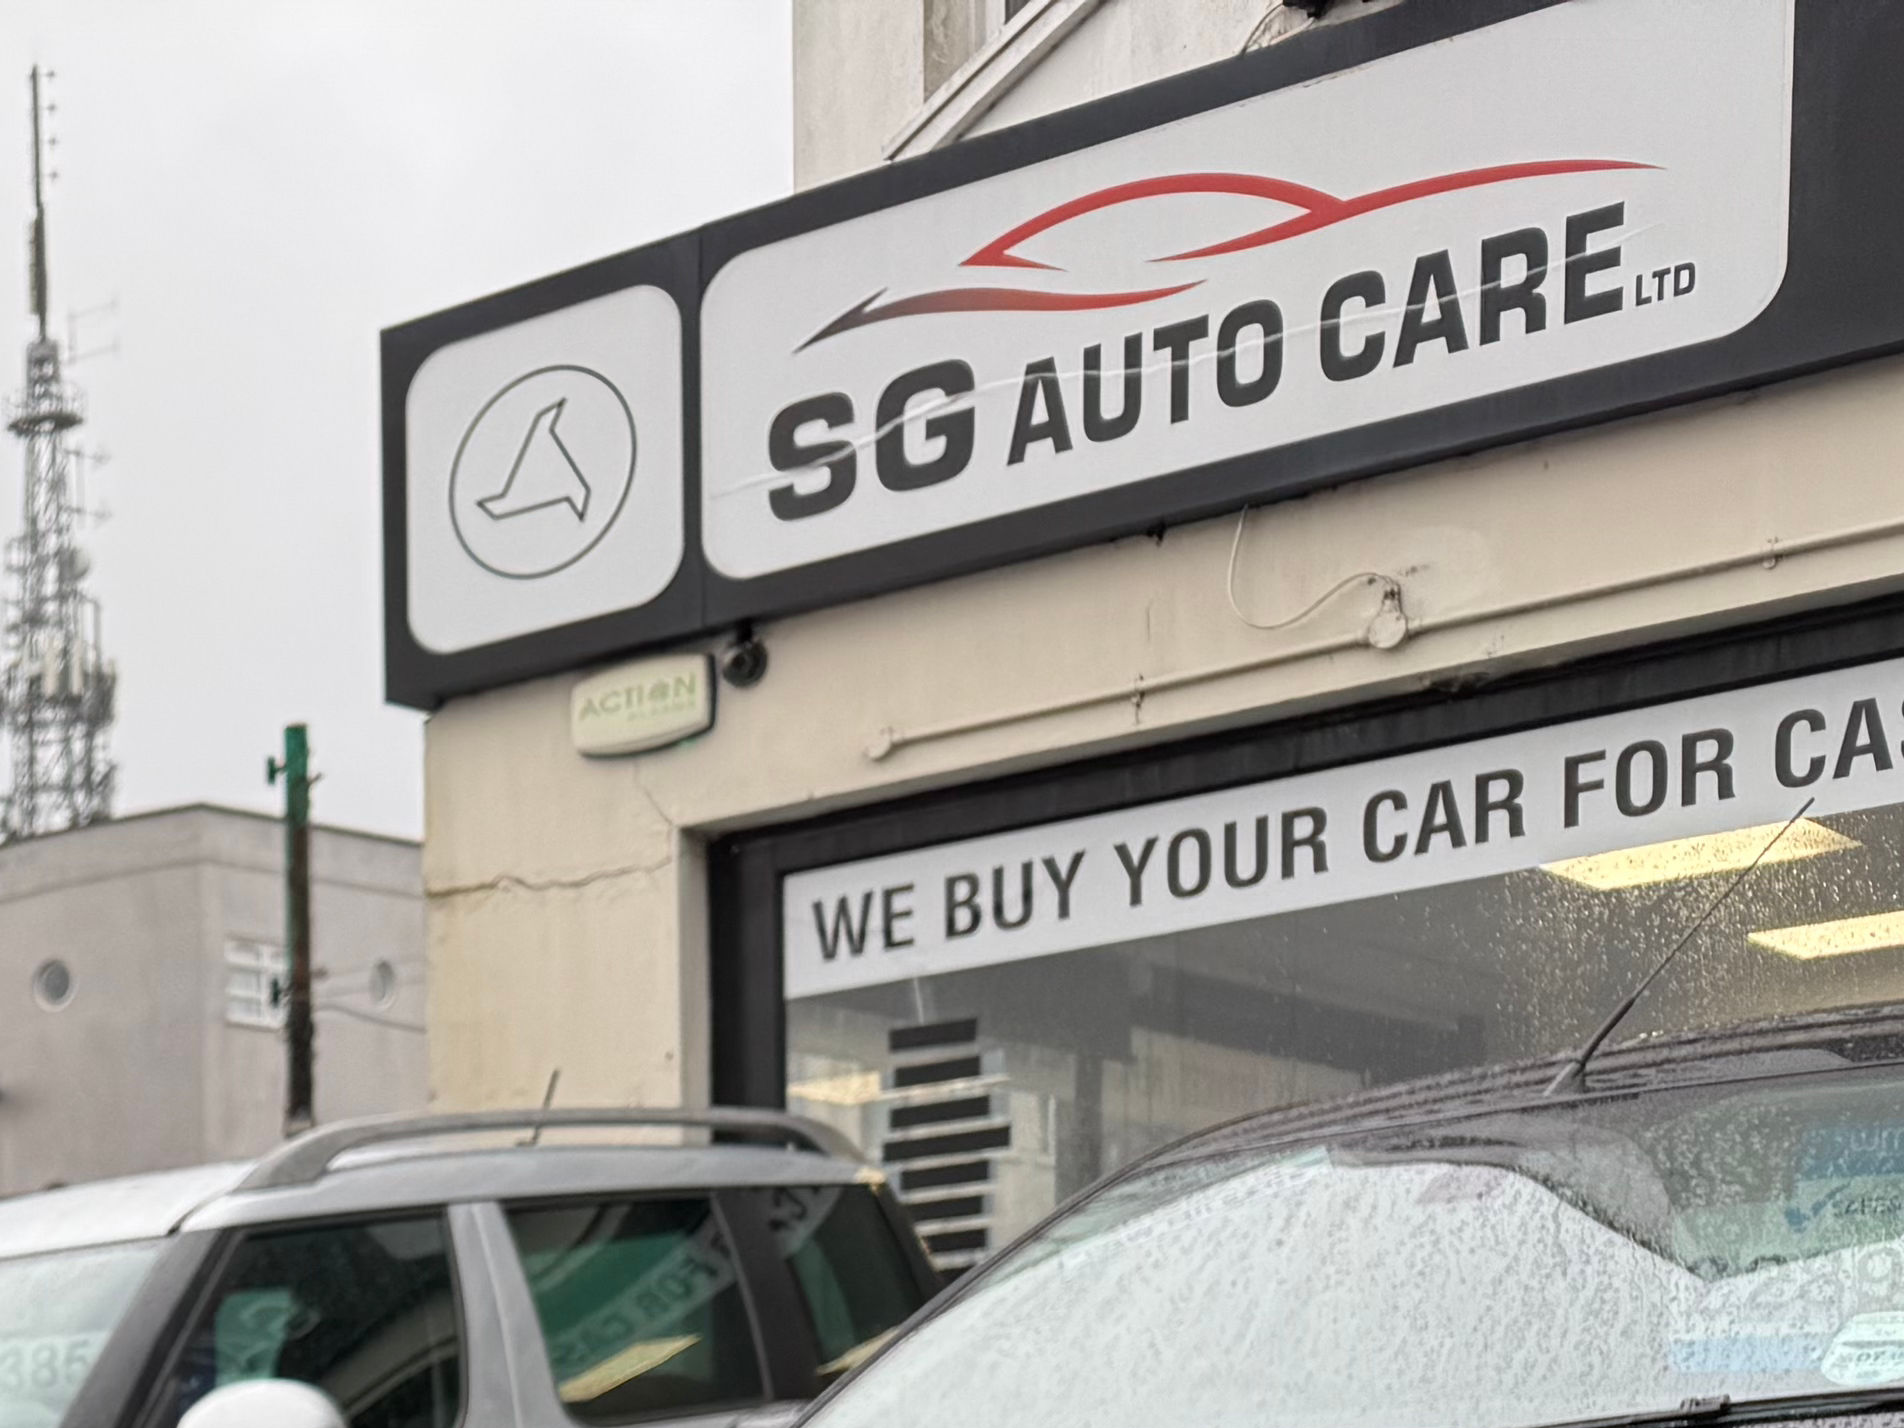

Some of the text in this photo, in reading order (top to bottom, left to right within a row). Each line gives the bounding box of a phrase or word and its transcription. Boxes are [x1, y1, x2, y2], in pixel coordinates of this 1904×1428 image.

[767, 200, 1696, 523] SG AUTO CARE LTD
[812, 697, 1904, 961] WE BUY YOUR CAR FOR CA
